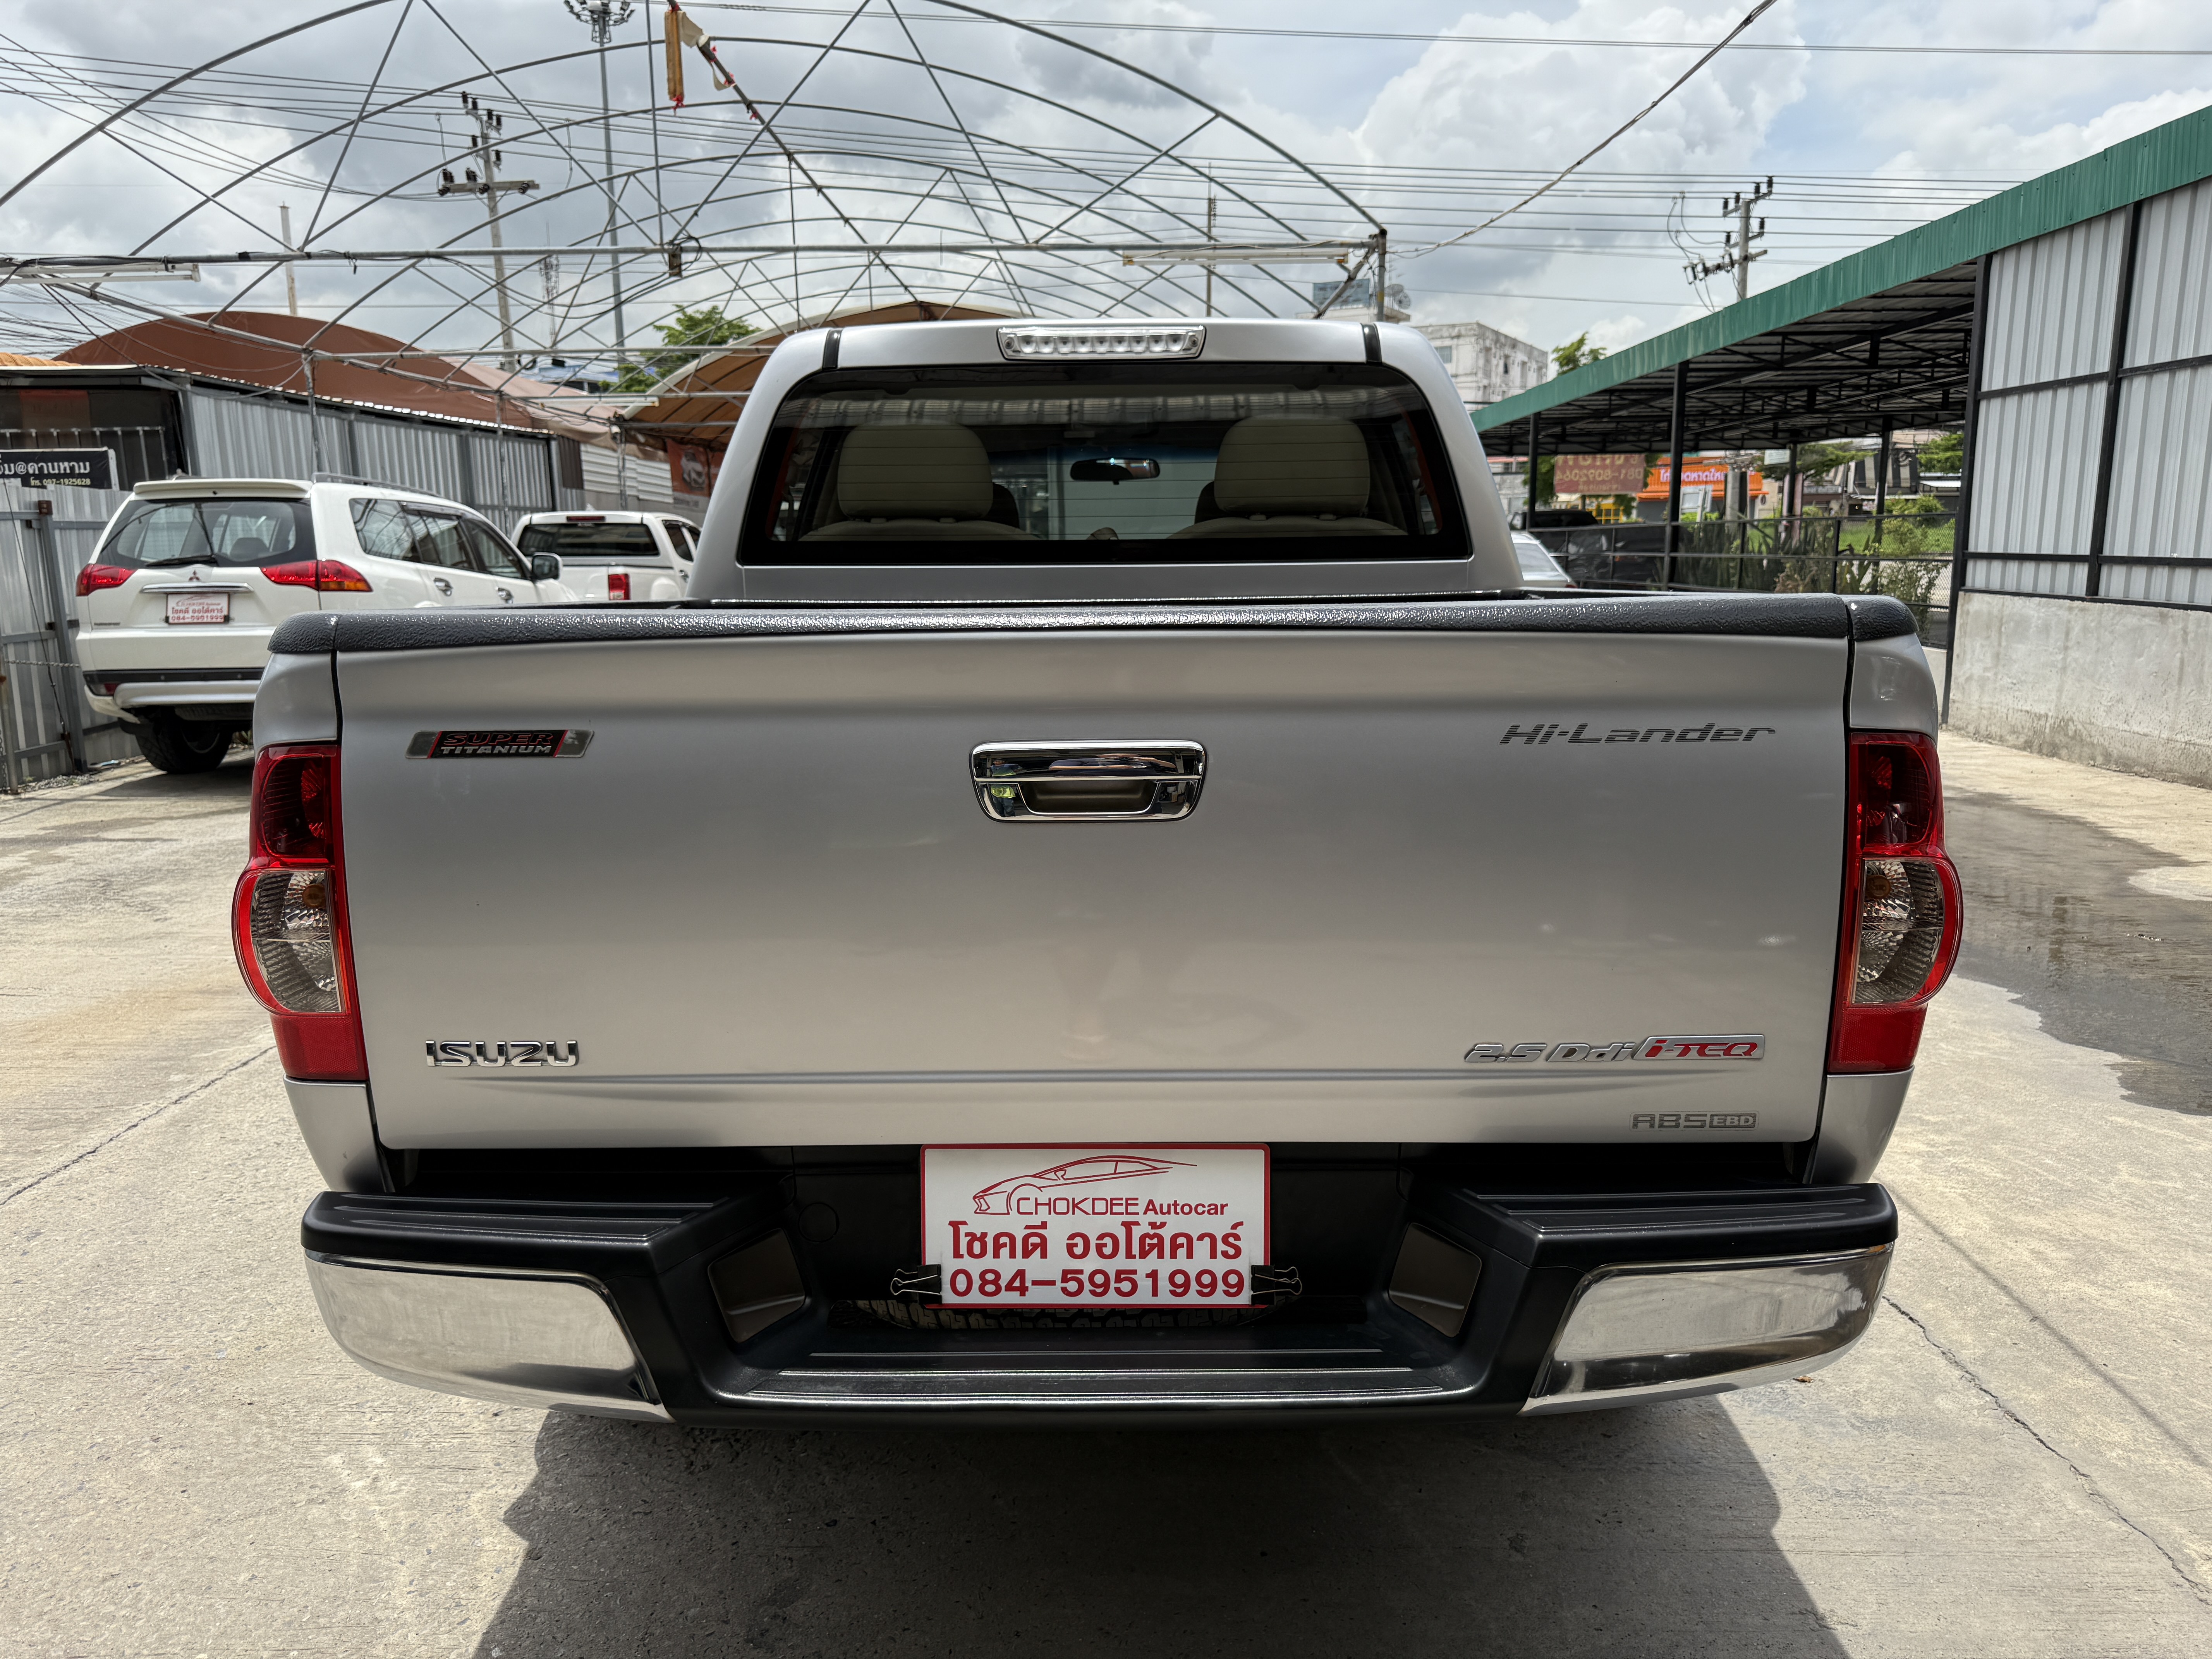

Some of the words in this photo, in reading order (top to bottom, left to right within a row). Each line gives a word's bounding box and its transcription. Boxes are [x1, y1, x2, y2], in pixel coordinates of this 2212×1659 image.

[443, 733, 553, 745] SUPER
[1499, 723, 1776, 745] Hi-Lander
[441, 746, 551, 754] TITANIUM
[426, 1041, 578, 1066] ISUZU
[1465, 1043, 1547, 1062] 2.5
[1645, 1039, 1758, 1058] i-TEQ
[1632, 1114, 1707, 1129] ABS
[1713, 1115, 1754, 1126] EBD
[1017, 1197, 1139, 1216] CHOKDEE
[1143, 1199, 1228, 1216] Autocar
[948, 1220, 1048, 1259] โชคดี
[1066, 1221, 1244, 1260] ออโต้คาร์
[950, 1268, 1245, 1298] 084-5951999
